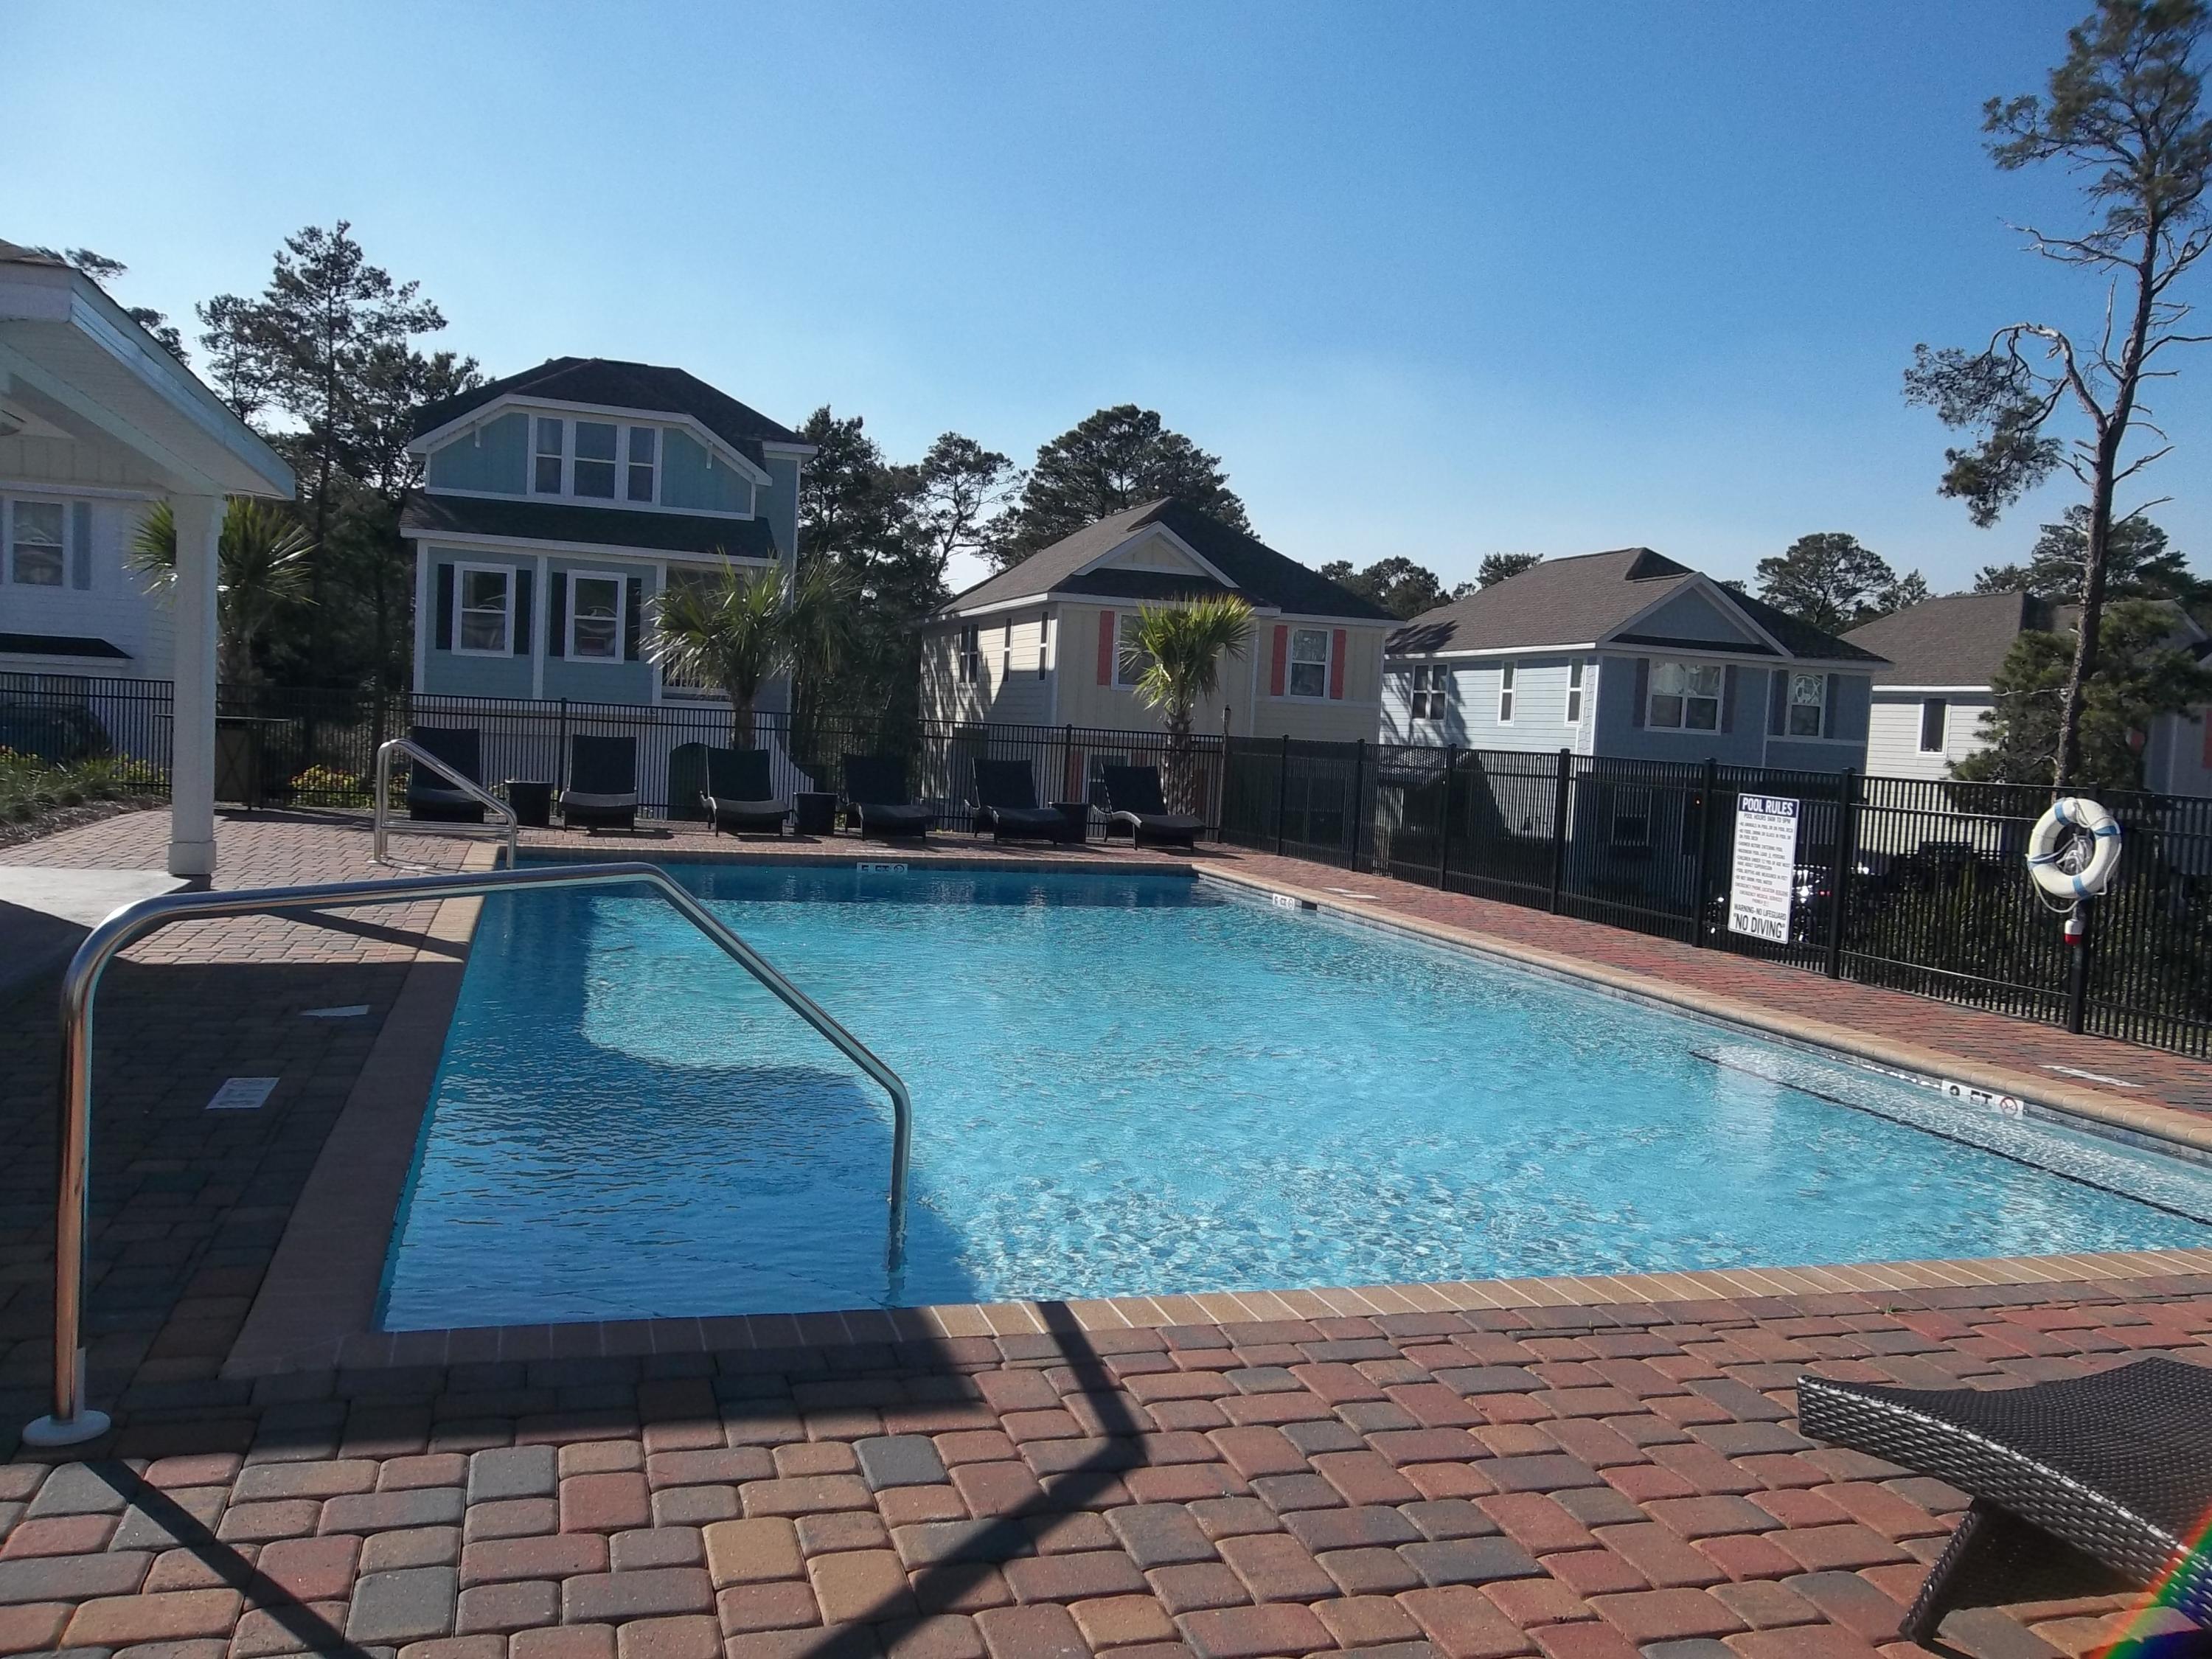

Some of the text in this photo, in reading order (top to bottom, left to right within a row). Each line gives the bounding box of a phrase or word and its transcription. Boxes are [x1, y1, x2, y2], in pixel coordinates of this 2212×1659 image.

[1742, 797, 1794, 815] POOL RULES
[1750, 917, 1785, 939] DIVING"
